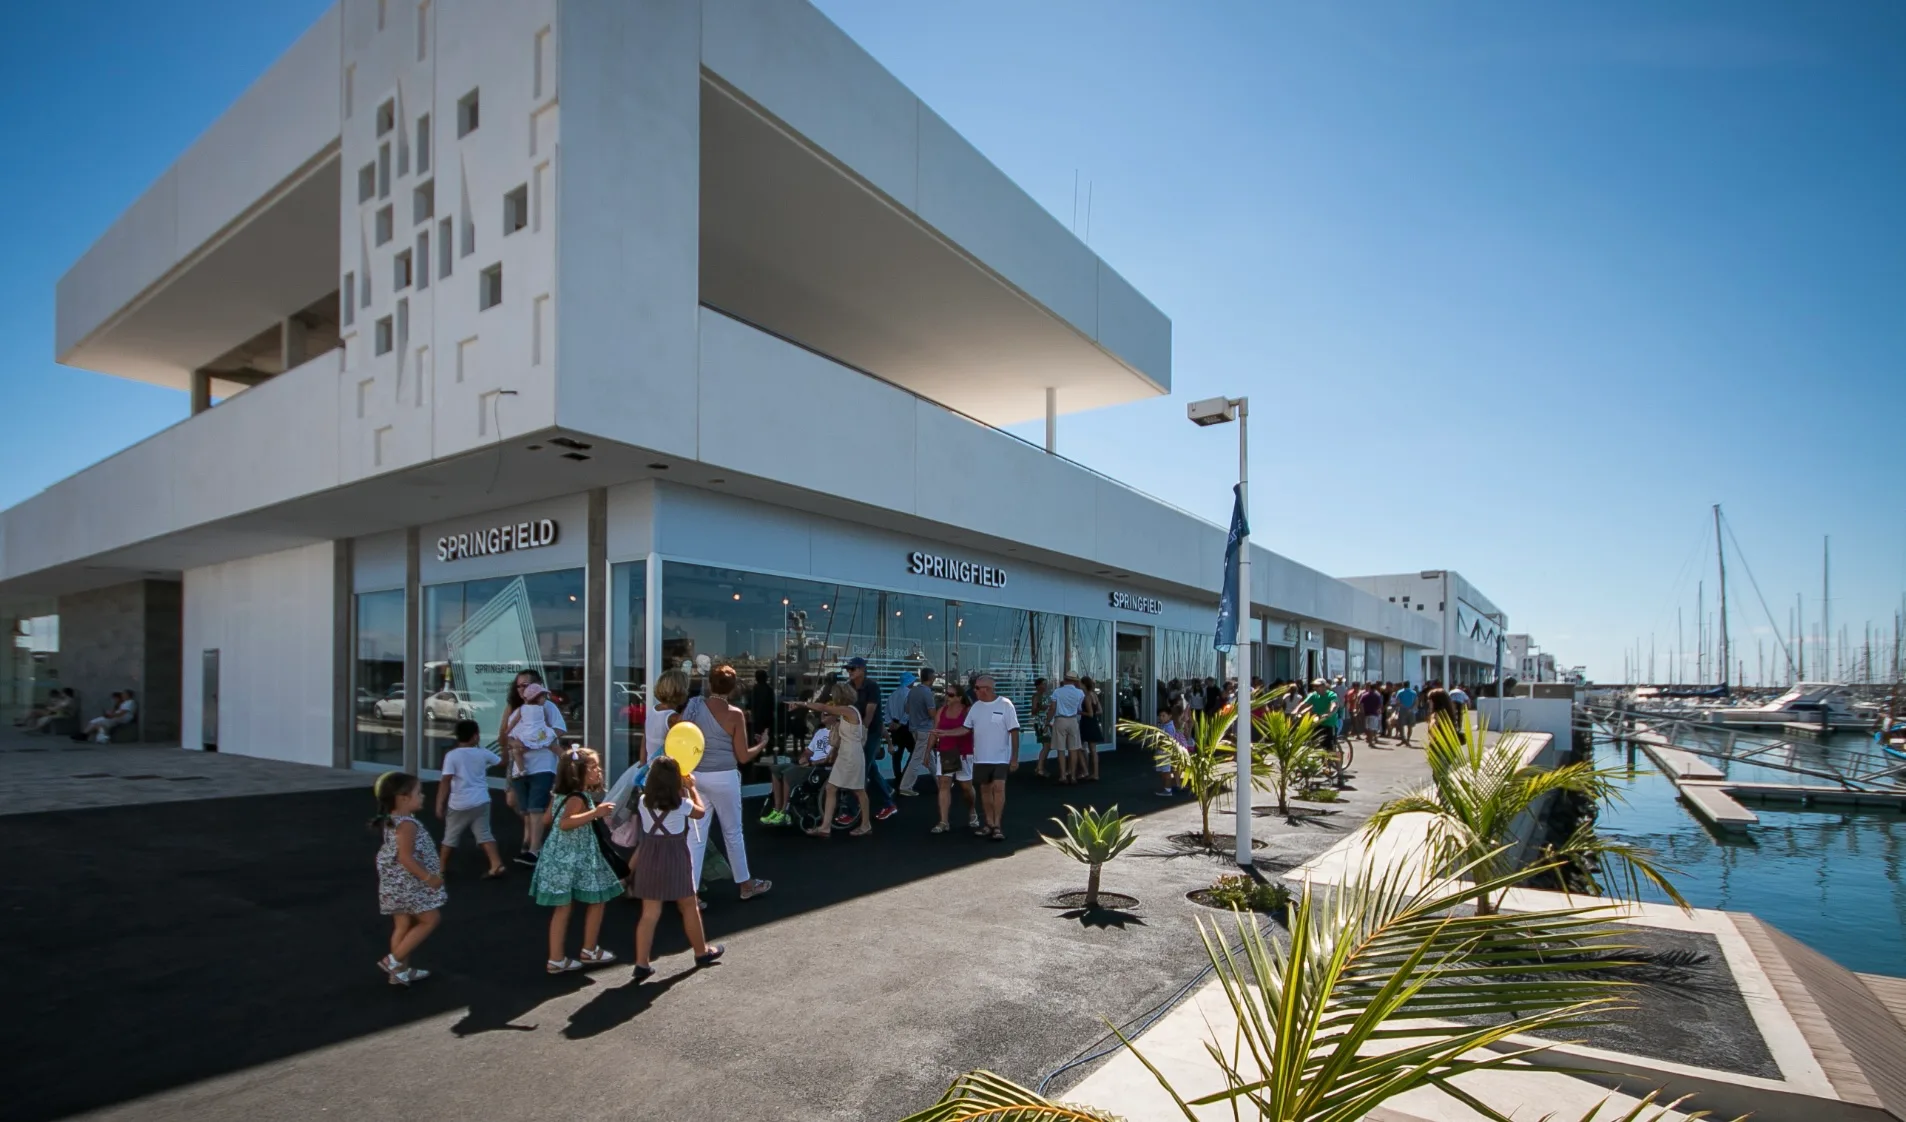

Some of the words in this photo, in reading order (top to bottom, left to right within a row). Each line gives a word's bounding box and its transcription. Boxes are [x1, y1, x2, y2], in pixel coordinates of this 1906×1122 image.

[437, 518, 555, 562] SPRINGFIELD
[911, 551, 1008, 588] SPRINGFIELD
[1112, 591, 1163, 615] SPRINGFIELD
[852, 644, 876, 655] Casual
[474, 663, 521, 674] SPRINGFIELD
